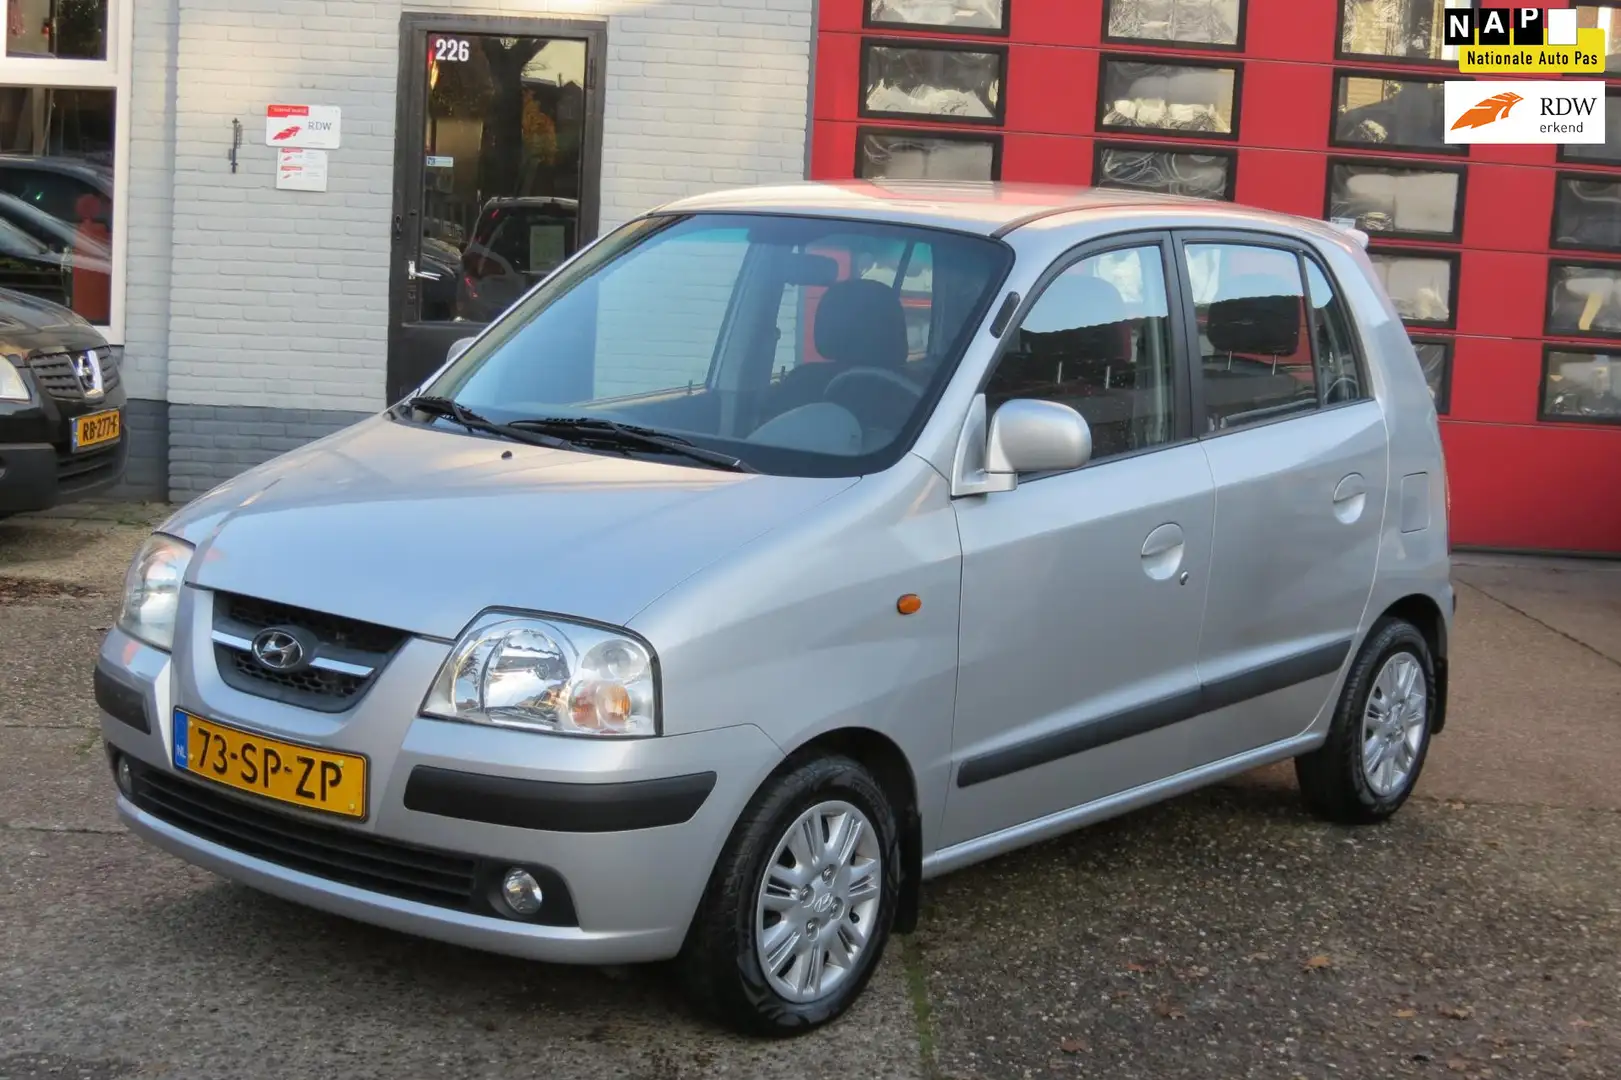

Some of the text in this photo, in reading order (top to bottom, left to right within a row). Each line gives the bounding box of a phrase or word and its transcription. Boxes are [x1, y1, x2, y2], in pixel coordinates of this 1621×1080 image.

[435, 39, 470, 62] 226
[307, 121, 333, 132] RDW
[198, 727, 343, 802] 73-SP-ZP
